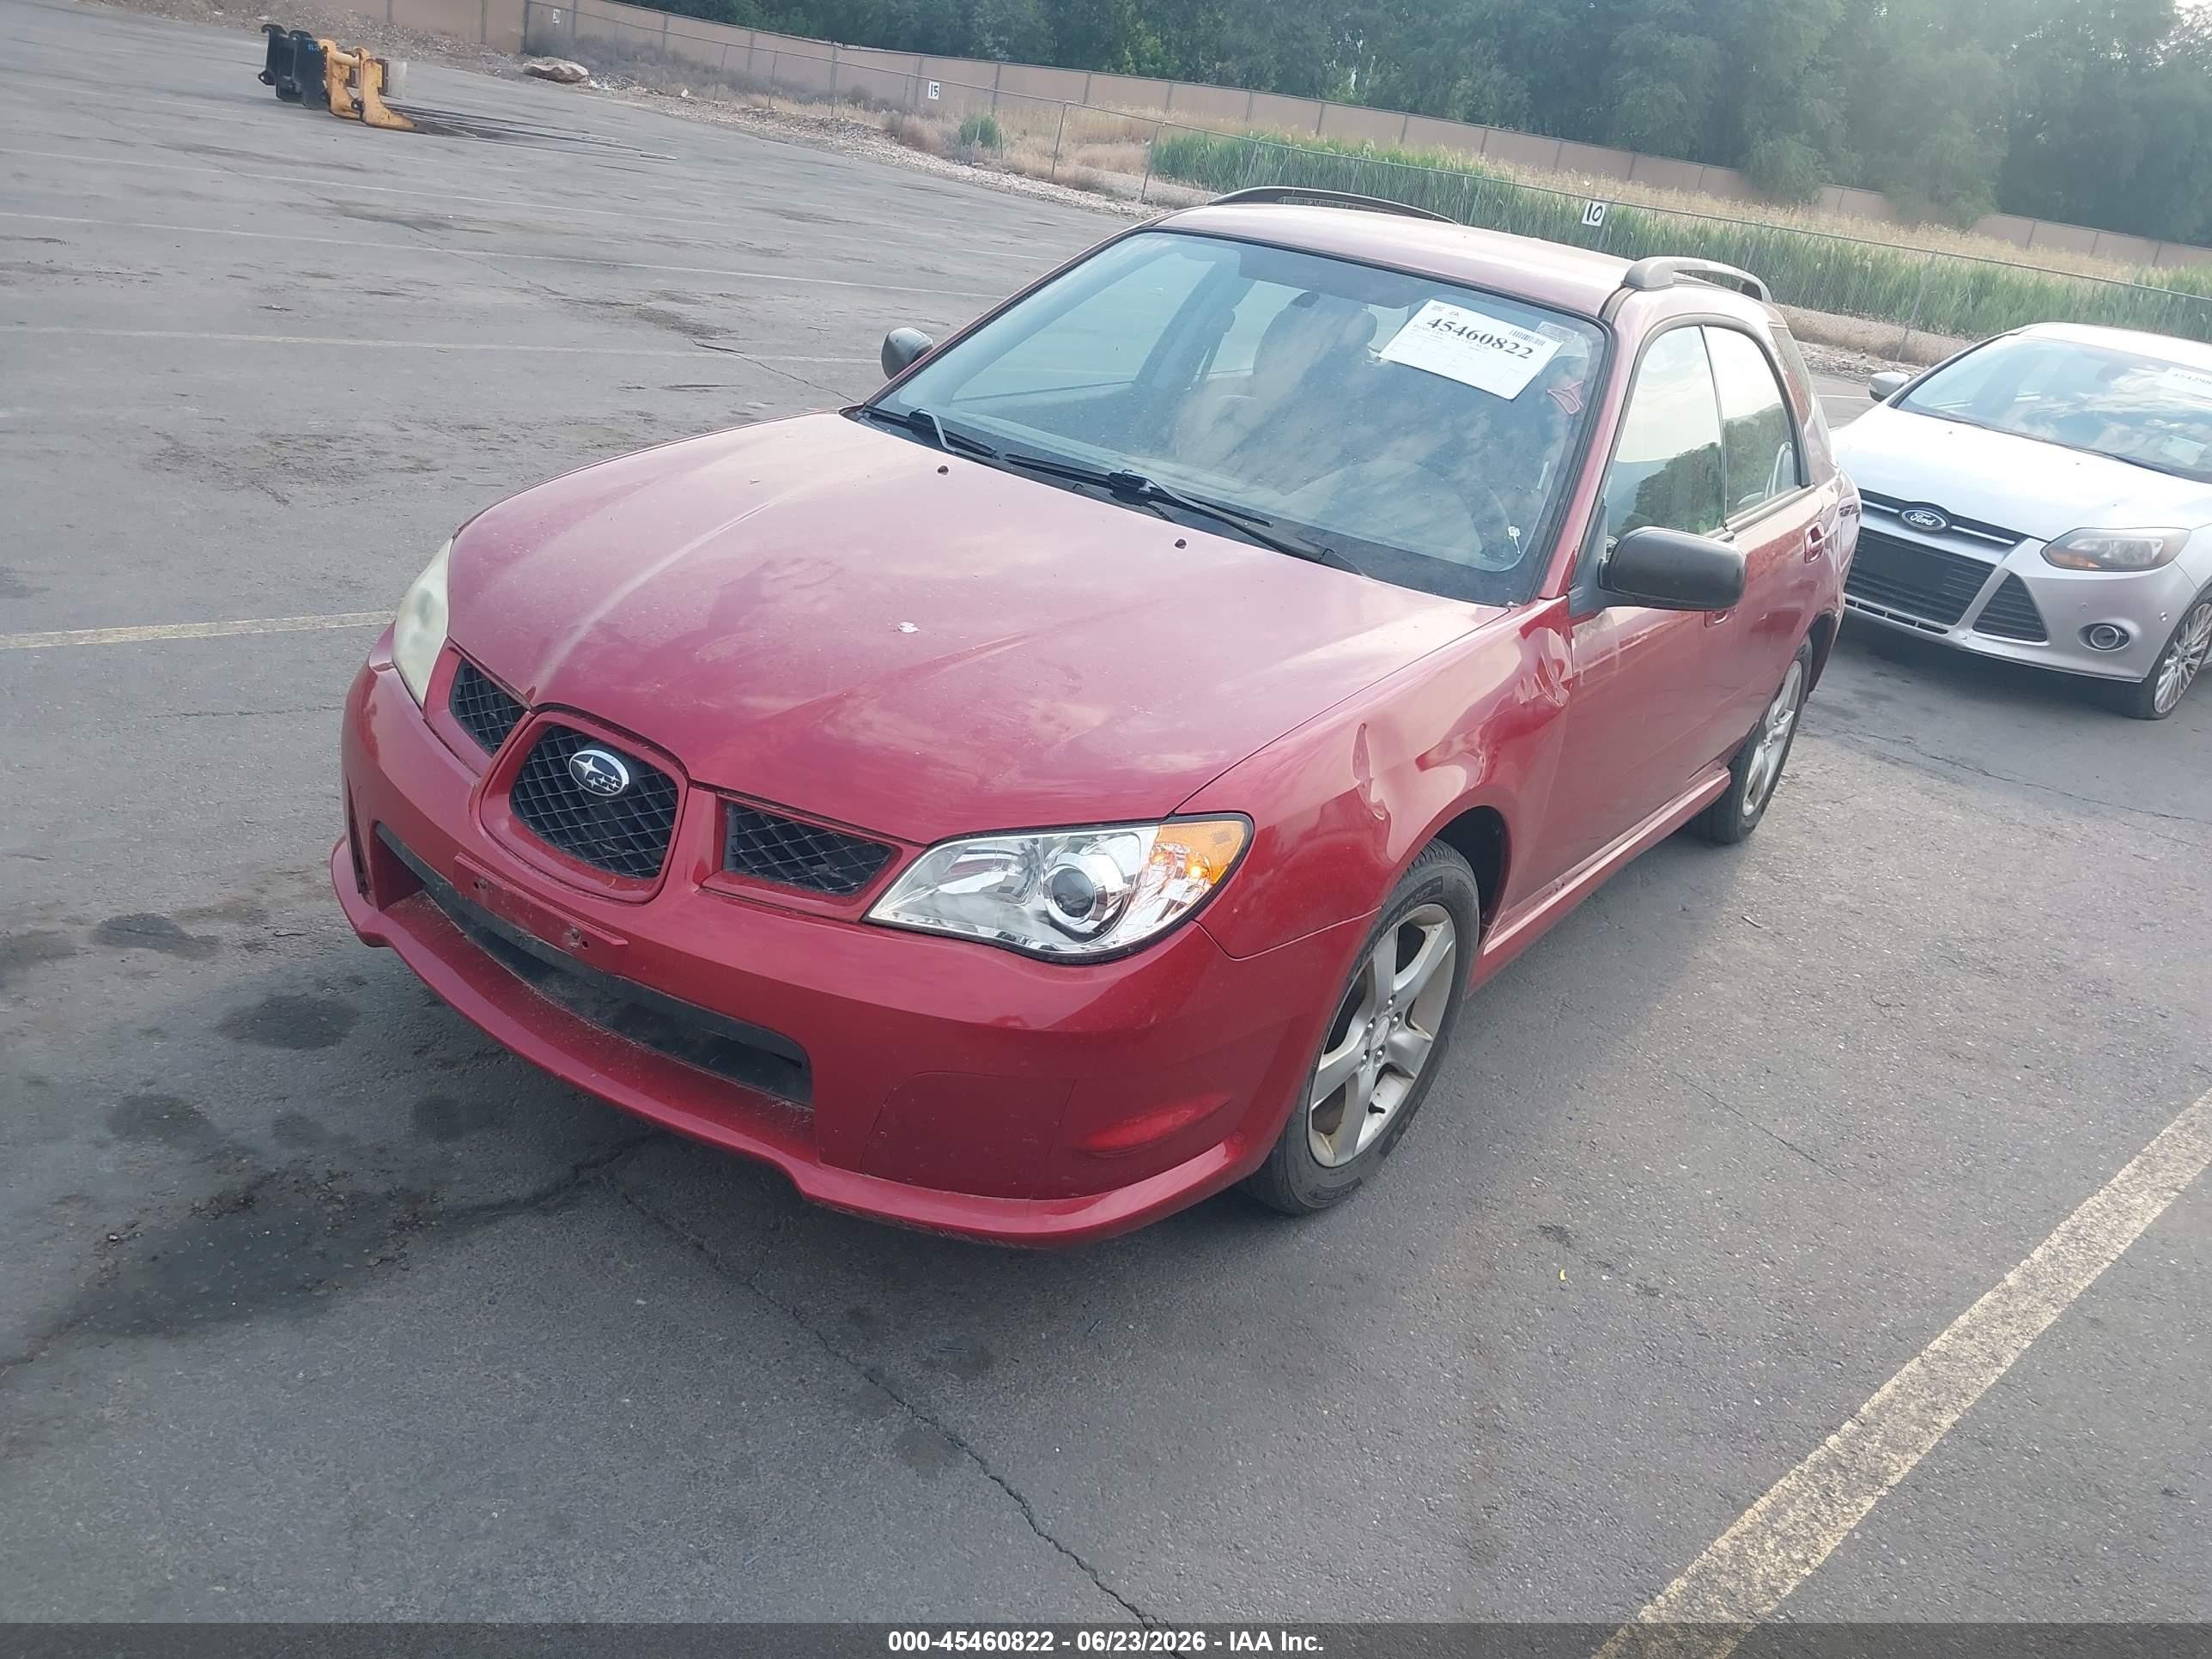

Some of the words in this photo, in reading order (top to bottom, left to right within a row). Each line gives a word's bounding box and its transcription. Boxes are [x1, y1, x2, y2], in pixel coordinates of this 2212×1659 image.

[930, 83, 939, 97] 15
[1586, 202, 1603, 222] 10
[1426, 318, 1534, 359] 45460822
[1910, 512, 1936, 526] Ford
